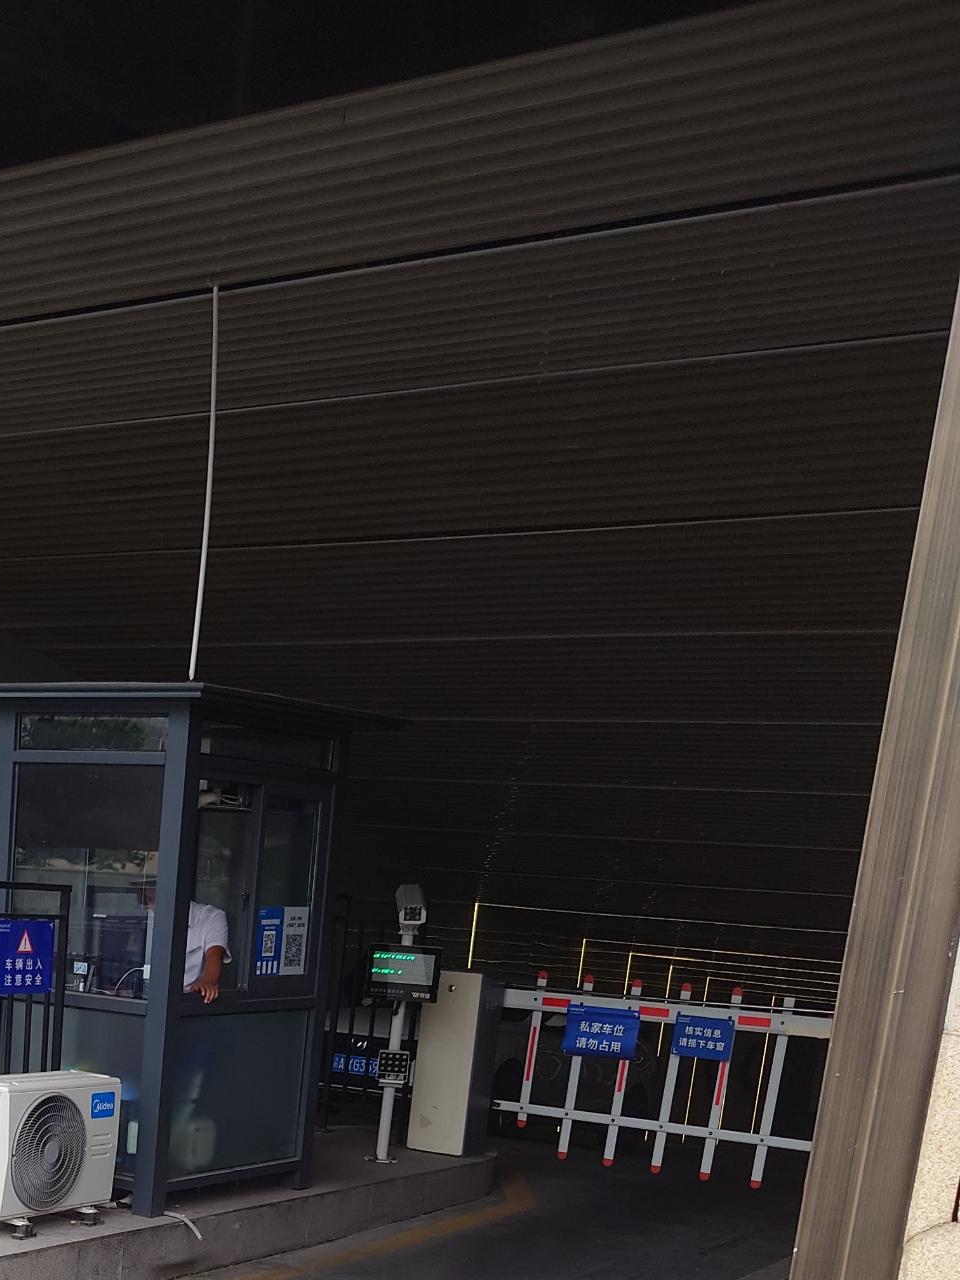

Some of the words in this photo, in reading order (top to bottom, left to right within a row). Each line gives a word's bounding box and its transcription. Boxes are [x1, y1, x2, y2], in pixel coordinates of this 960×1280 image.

[4, 958, 43, 971] 车辆出入
[4, 973, 42, 986] 注意安全
[579, 1021, 625, 1036] 私家车位
[685, 1025, 721, 1039] 核实信息
[576, 1036, 621, 1053] 请勿占用
[679, 1037, 725, 1051] 请摇下车窗
[93, 1099, 114, 1113] Midea
